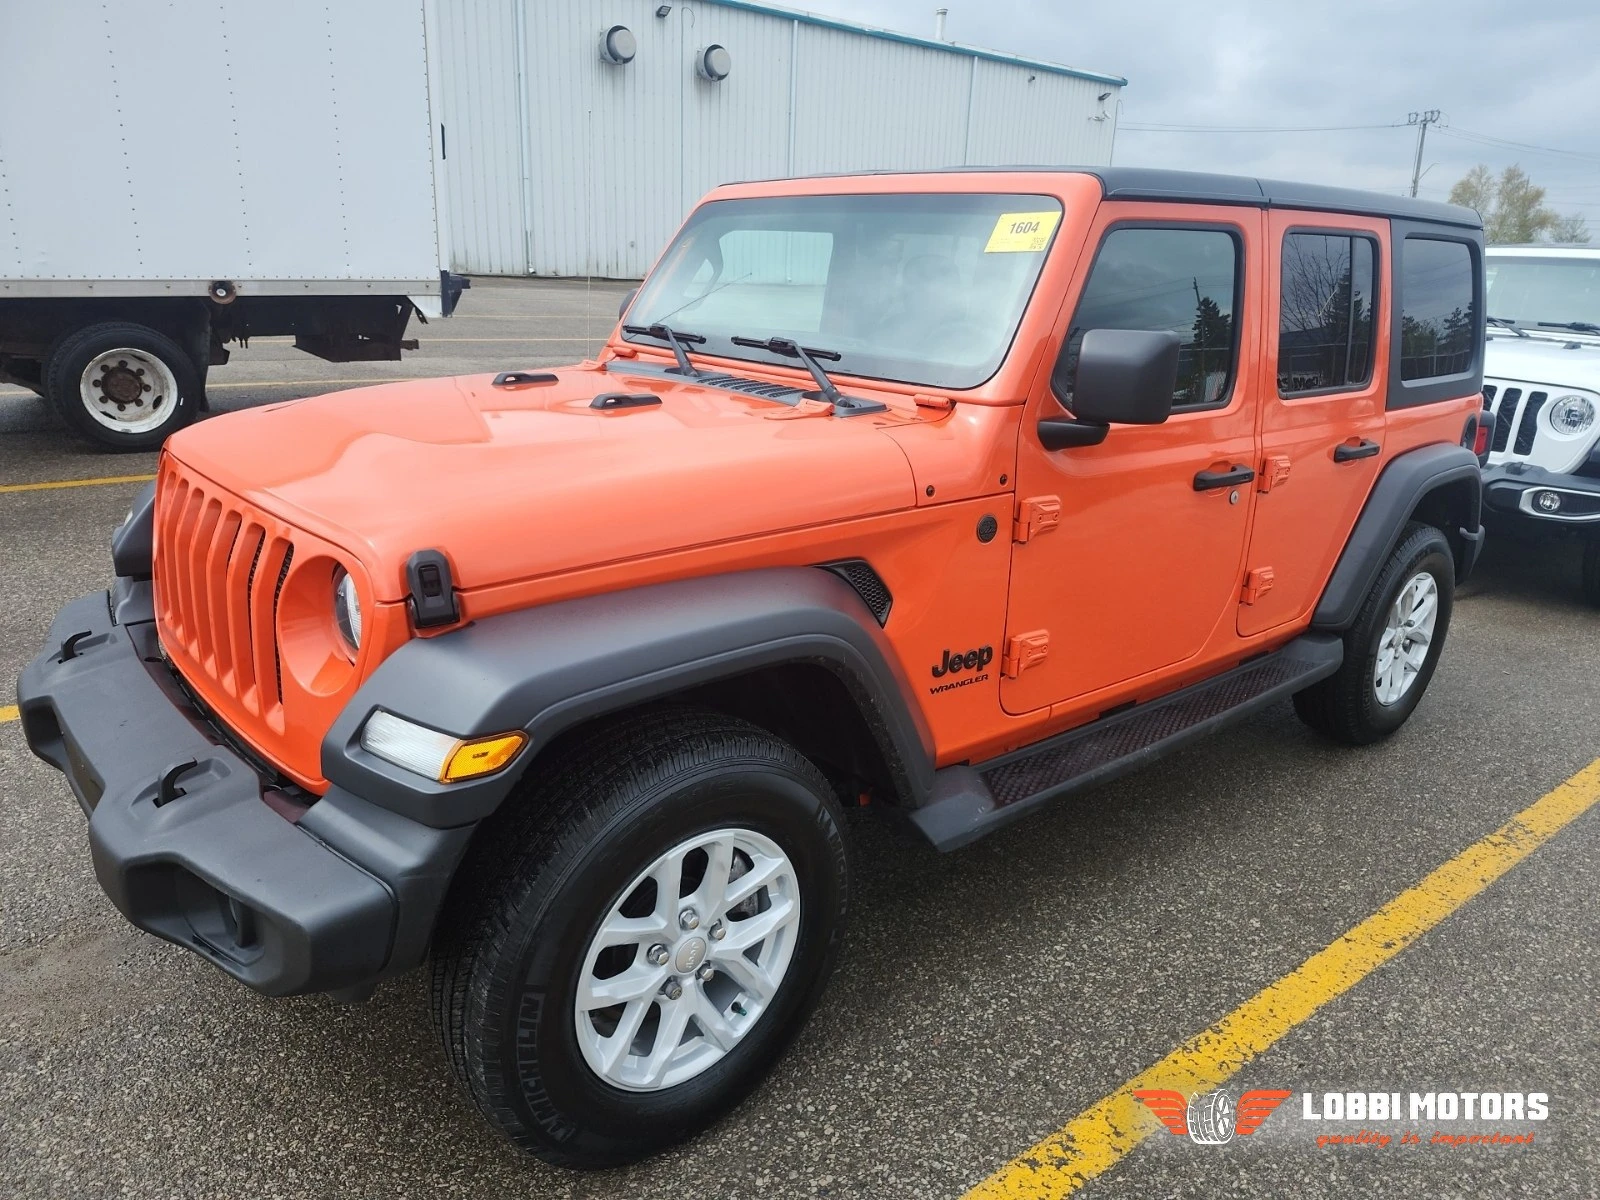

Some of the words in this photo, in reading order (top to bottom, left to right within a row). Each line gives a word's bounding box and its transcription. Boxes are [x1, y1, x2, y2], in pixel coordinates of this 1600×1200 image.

[1009, 221, 1041, 234] 1604
[931, 645, 993, 678] Jeep
[929, 674, 989, 695] WRANGLER
[516, 991, 564, 1127] MICHELIN
